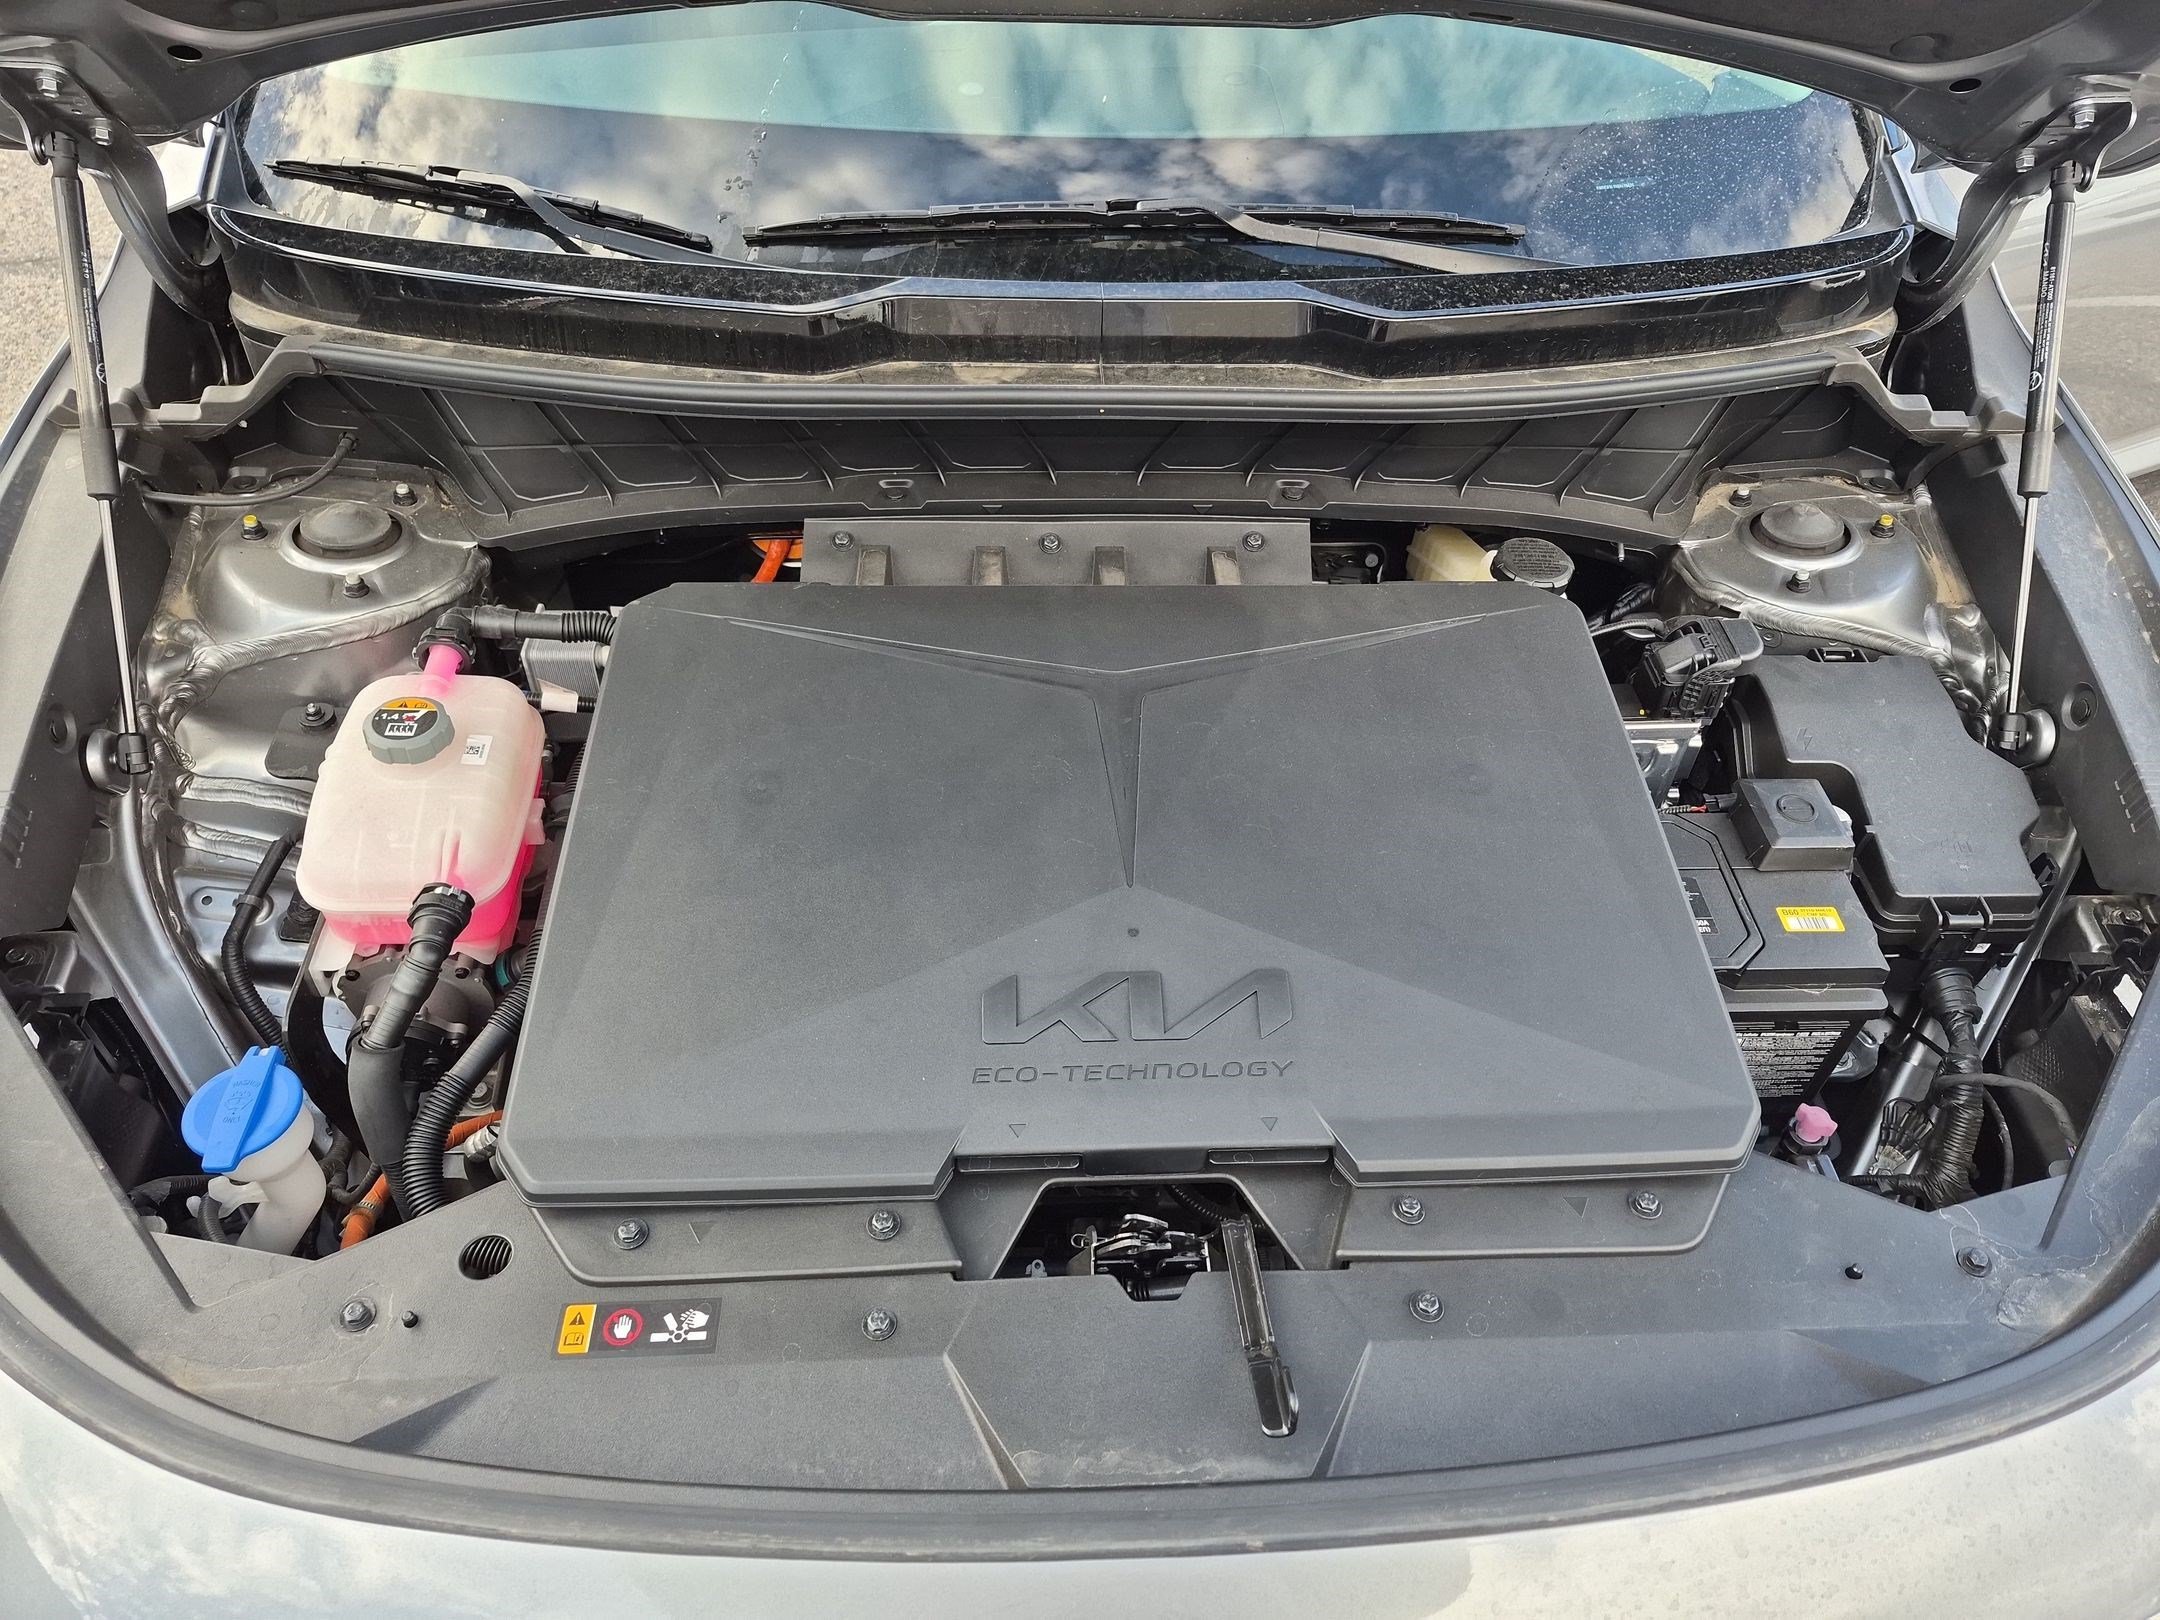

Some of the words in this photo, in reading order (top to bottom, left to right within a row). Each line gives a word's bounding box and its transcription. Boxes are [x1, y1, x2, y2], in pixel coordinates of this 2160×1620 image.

[2041, 270, 2050, 298] MANDO
[981, 968, 1293, 1045] KIA
[972, 1060, 1294, 1084] ECO-TECHNOLOGY
